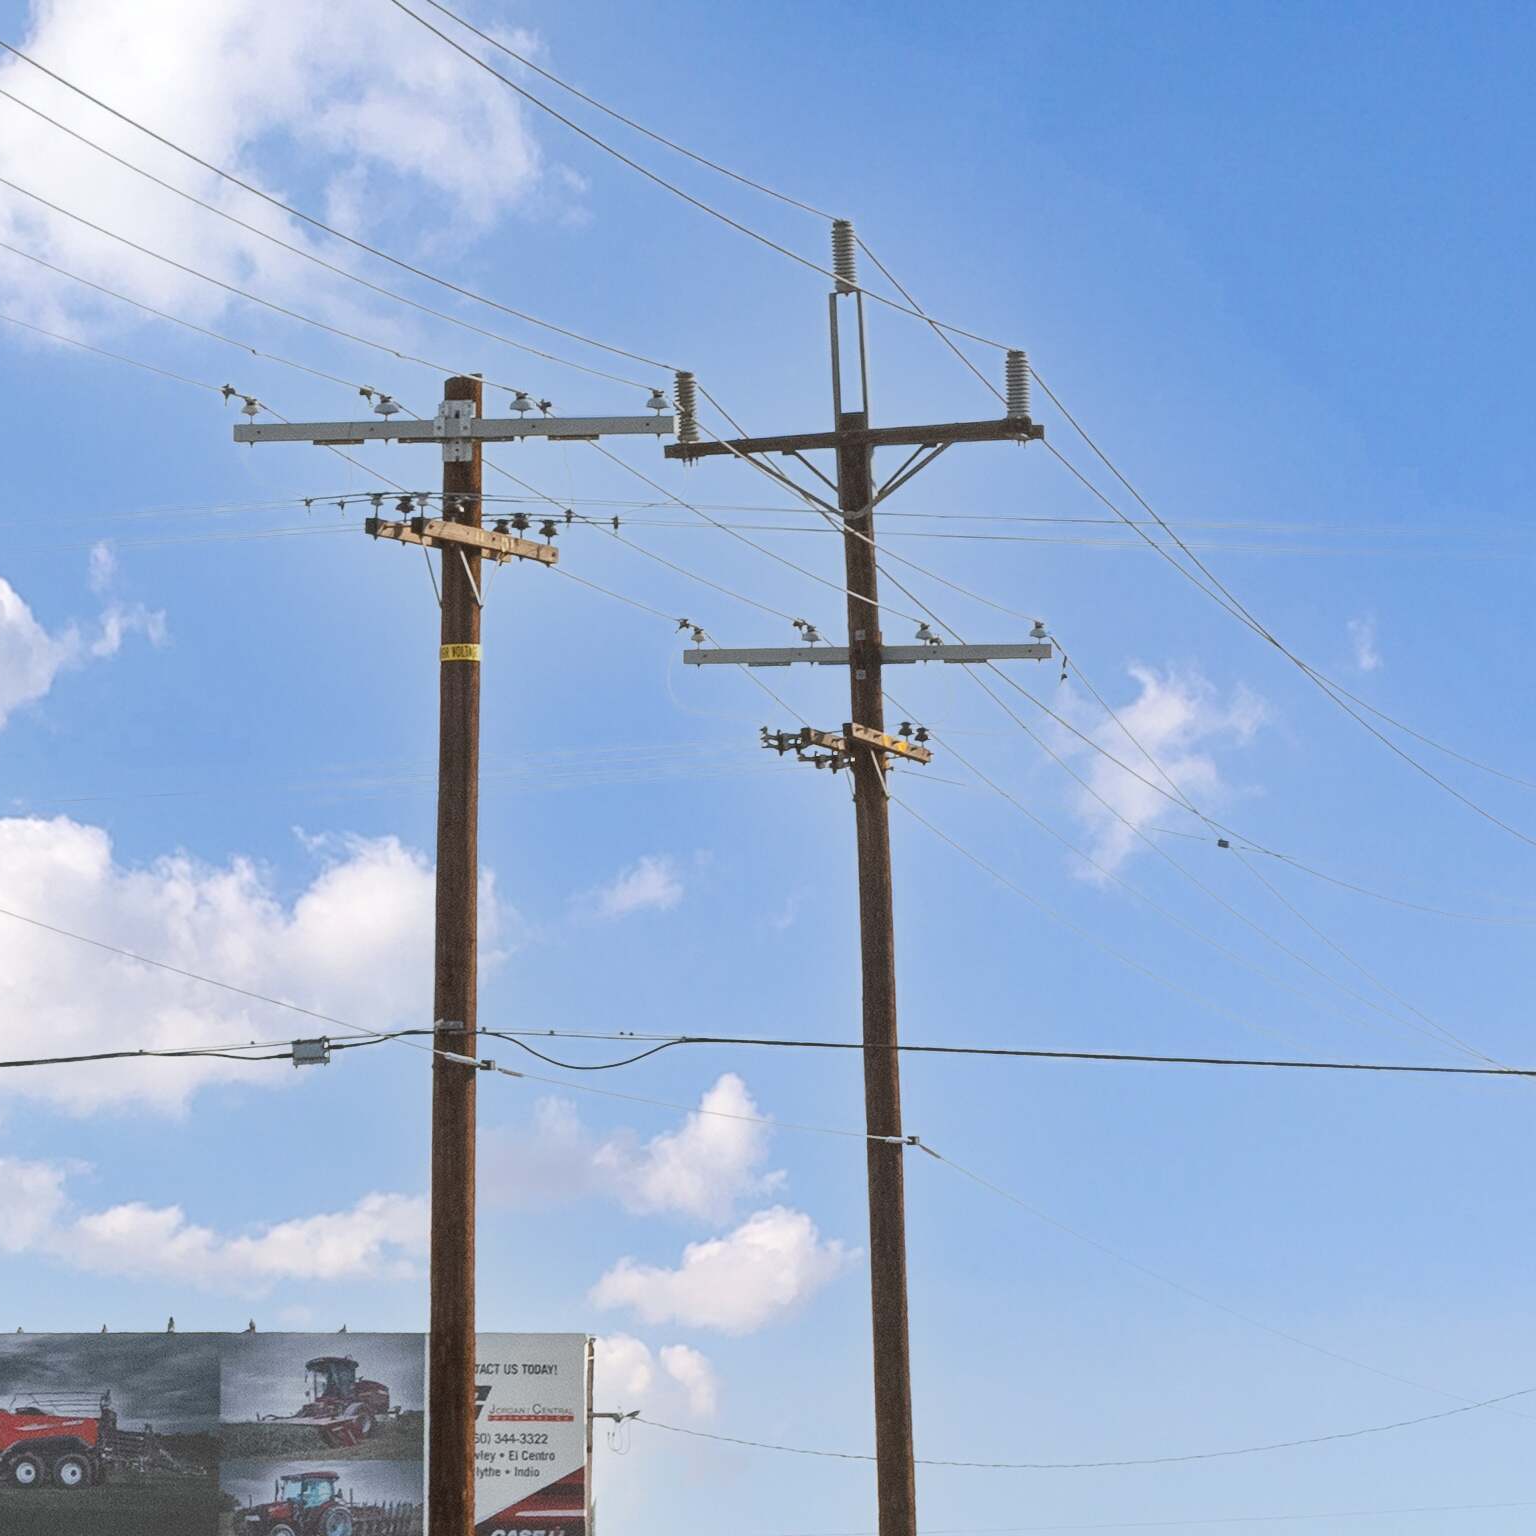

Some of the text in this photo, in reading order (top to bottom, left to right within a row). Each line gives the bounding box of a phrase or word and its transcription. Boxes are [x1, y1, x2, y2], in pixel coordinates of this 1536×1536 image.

[474, 1363, 558, 1376] TACT US TODAY!
[494, 1433, 548, 1445] 344-3322
[508, 1450, 519, 1461] El
[521, 1450, 556, 1461] Centro
[476, 1467, 540, 1479] lythe Indio
